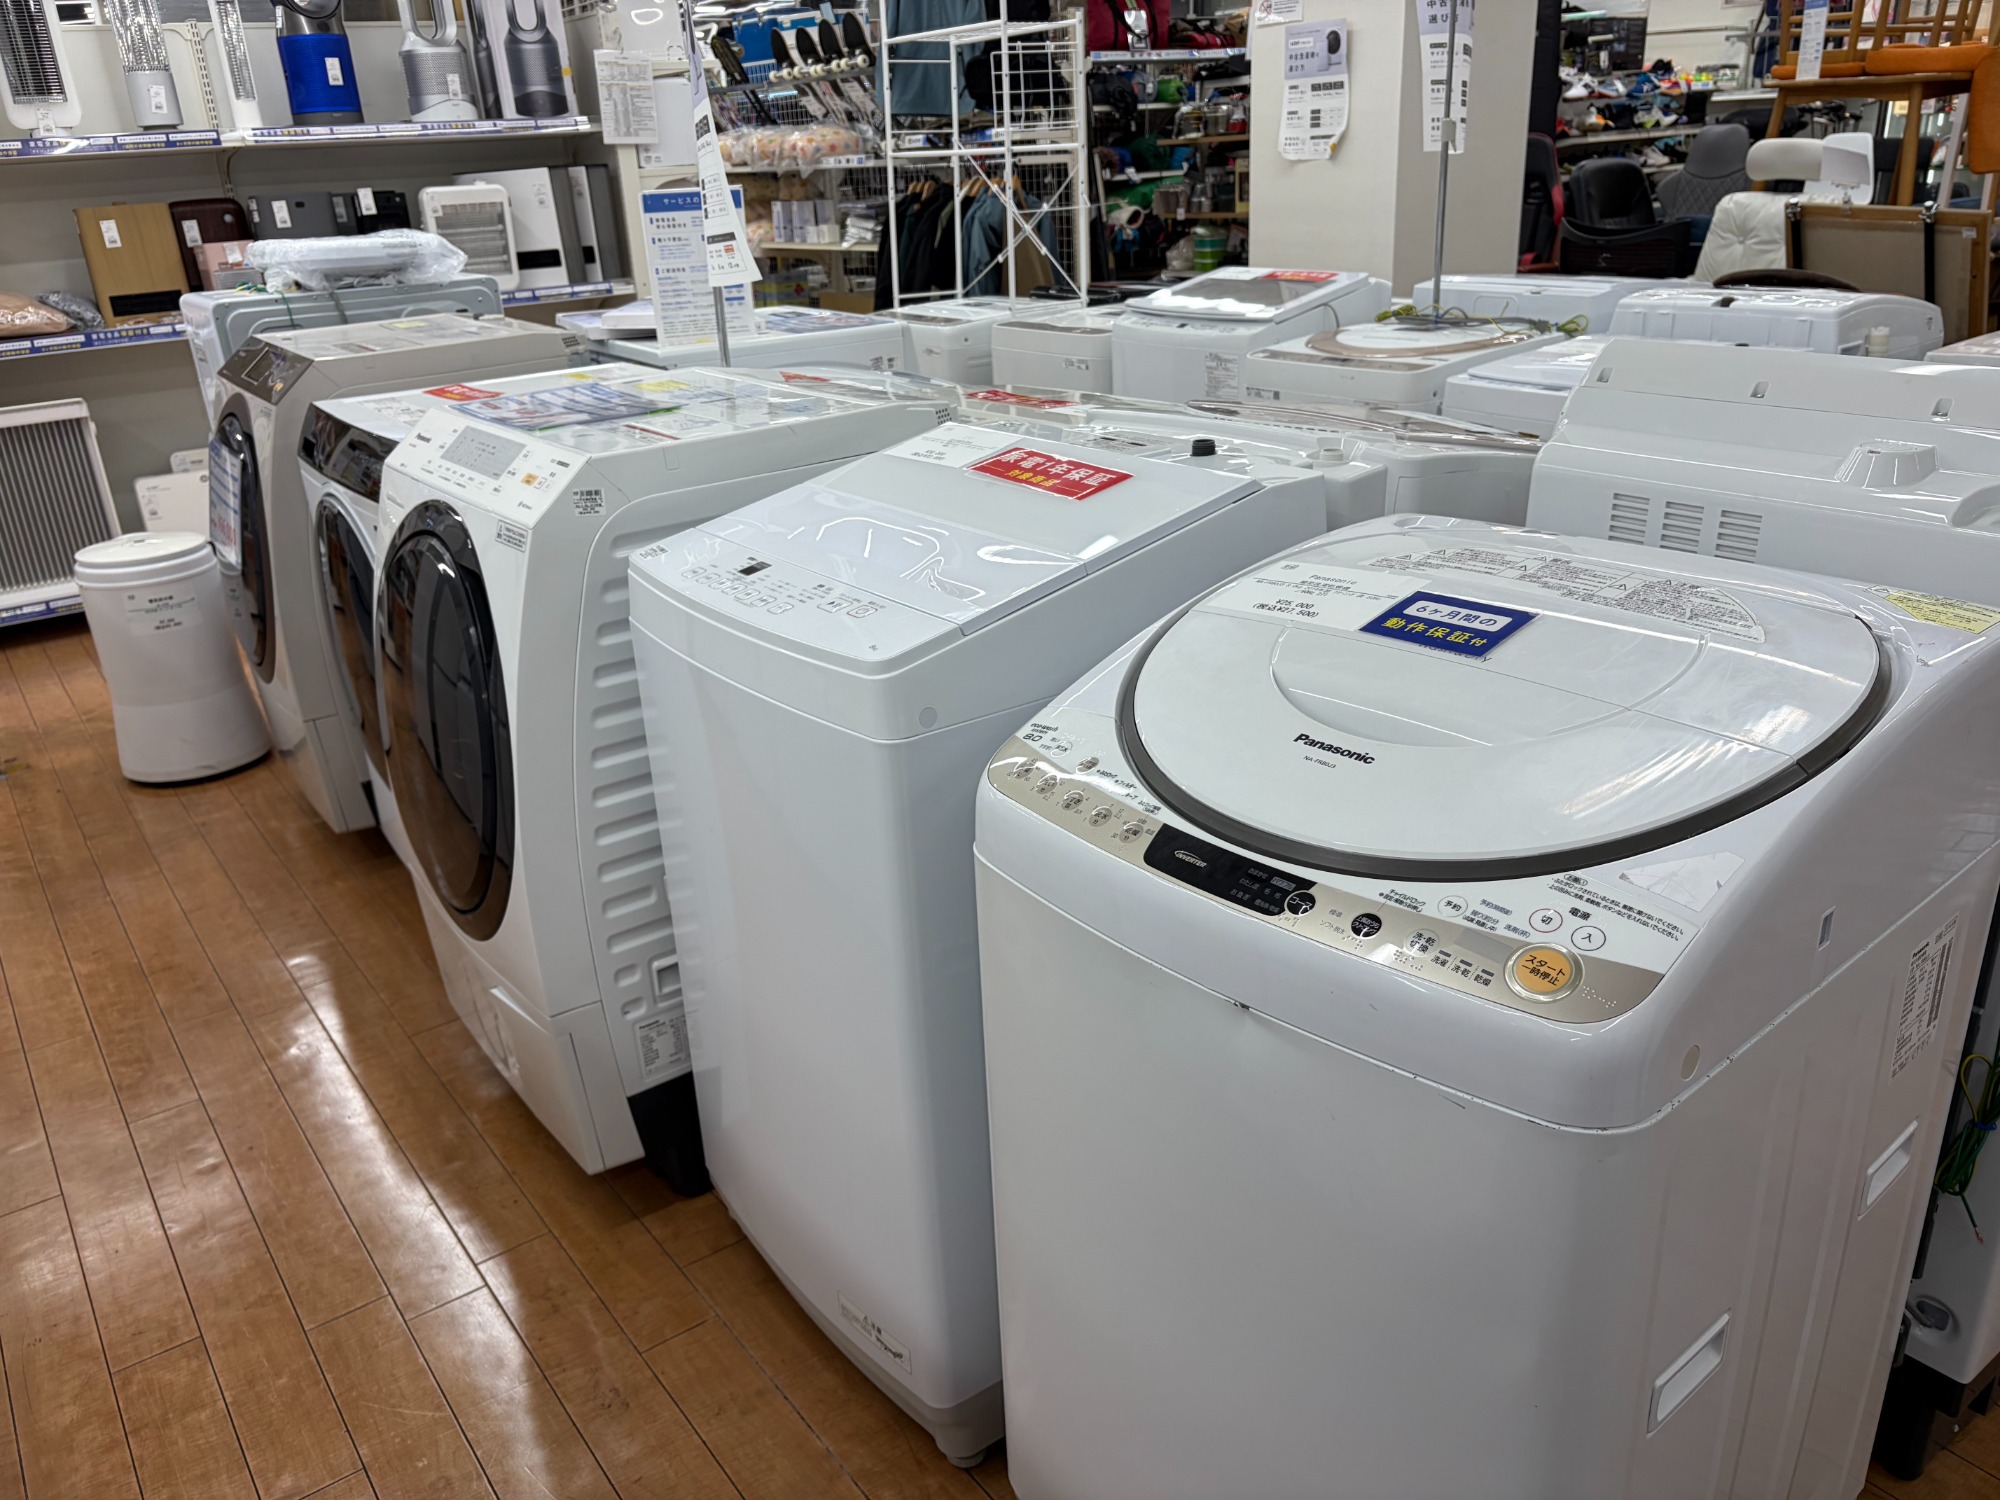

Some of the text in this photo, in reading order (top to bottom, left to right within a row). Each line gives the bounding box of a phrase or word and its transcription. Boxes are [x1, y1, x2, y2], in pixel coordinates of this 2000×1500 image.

[1000, 451, 1117, 486] 家電1年保証
[1309, 574, 1357, 585] Panasonic
[1381, 617, 1488, 647] 動作保証付
[1293, 733, 1375, 764] Panasonic
[1176, 851, 1207, 868] INVERTER
[1289, 896, 1312, 911] コース
[1443, 899, 1462, 912] 予約
[1540, 914, 1553, 926] 切
[1568, 906, 1592, 921] 電源
[1581, 933, 1592, 944] 入
[1409, 939, 1429, 954] 切換
[1431, 954, 1449, 968] 洗濯
[1524, 954, 1566, 977] スタート
[1473, 973, 1492, 987] 乾燥
[1522, 964, 1560, 986] 一時停止
